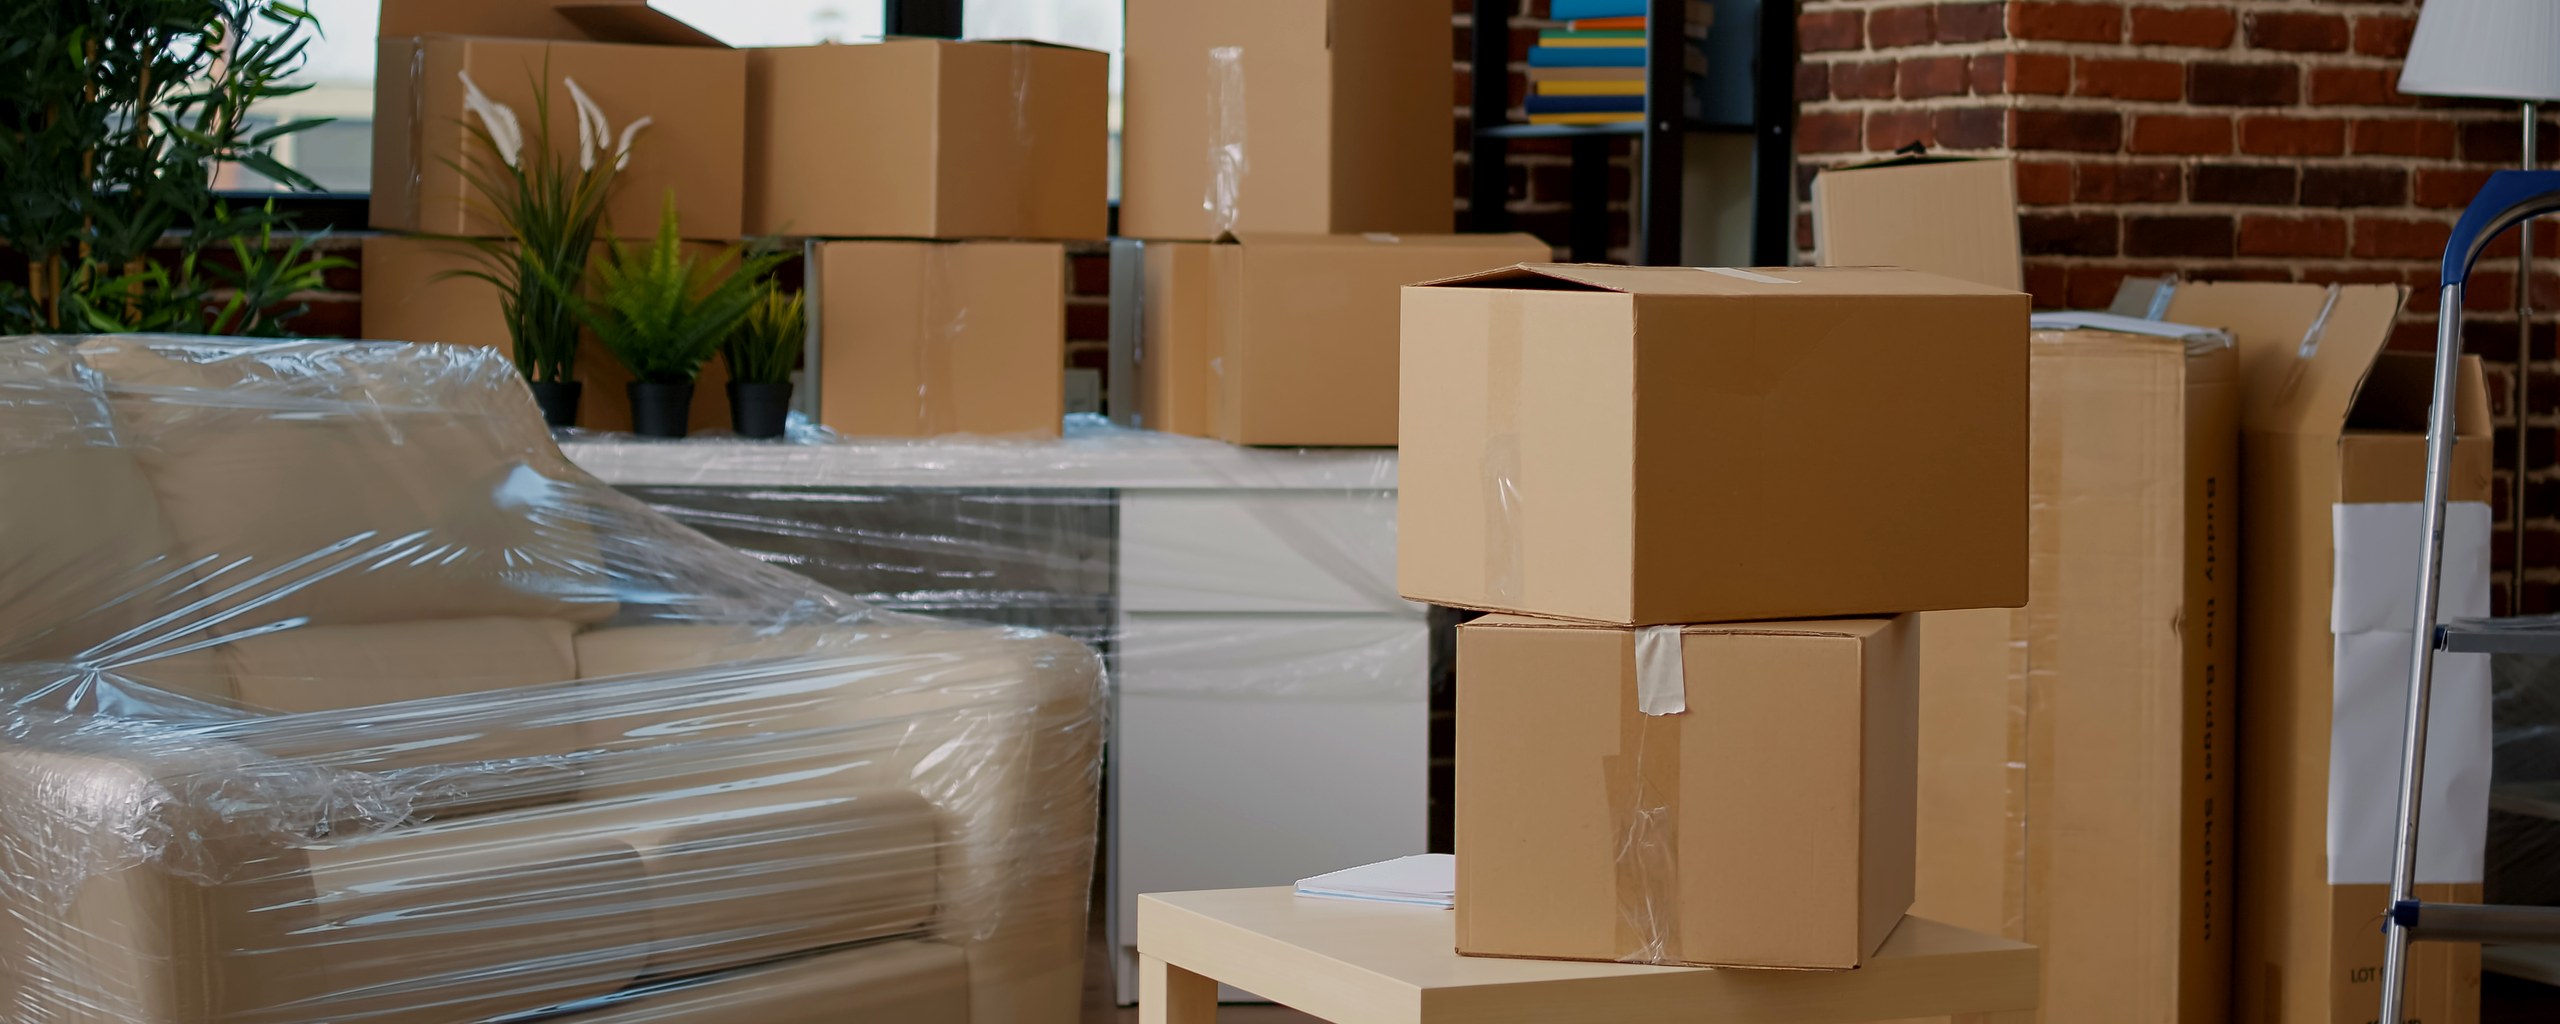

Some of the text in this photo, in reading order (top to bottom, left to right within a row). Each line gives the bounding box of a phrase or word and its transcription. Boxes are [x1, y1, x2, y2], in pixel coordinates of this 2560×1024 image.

[2203, 478, 2216, 942] Buddy the Budget Skeleton
[2351, 966, 2375, 983] LOT
